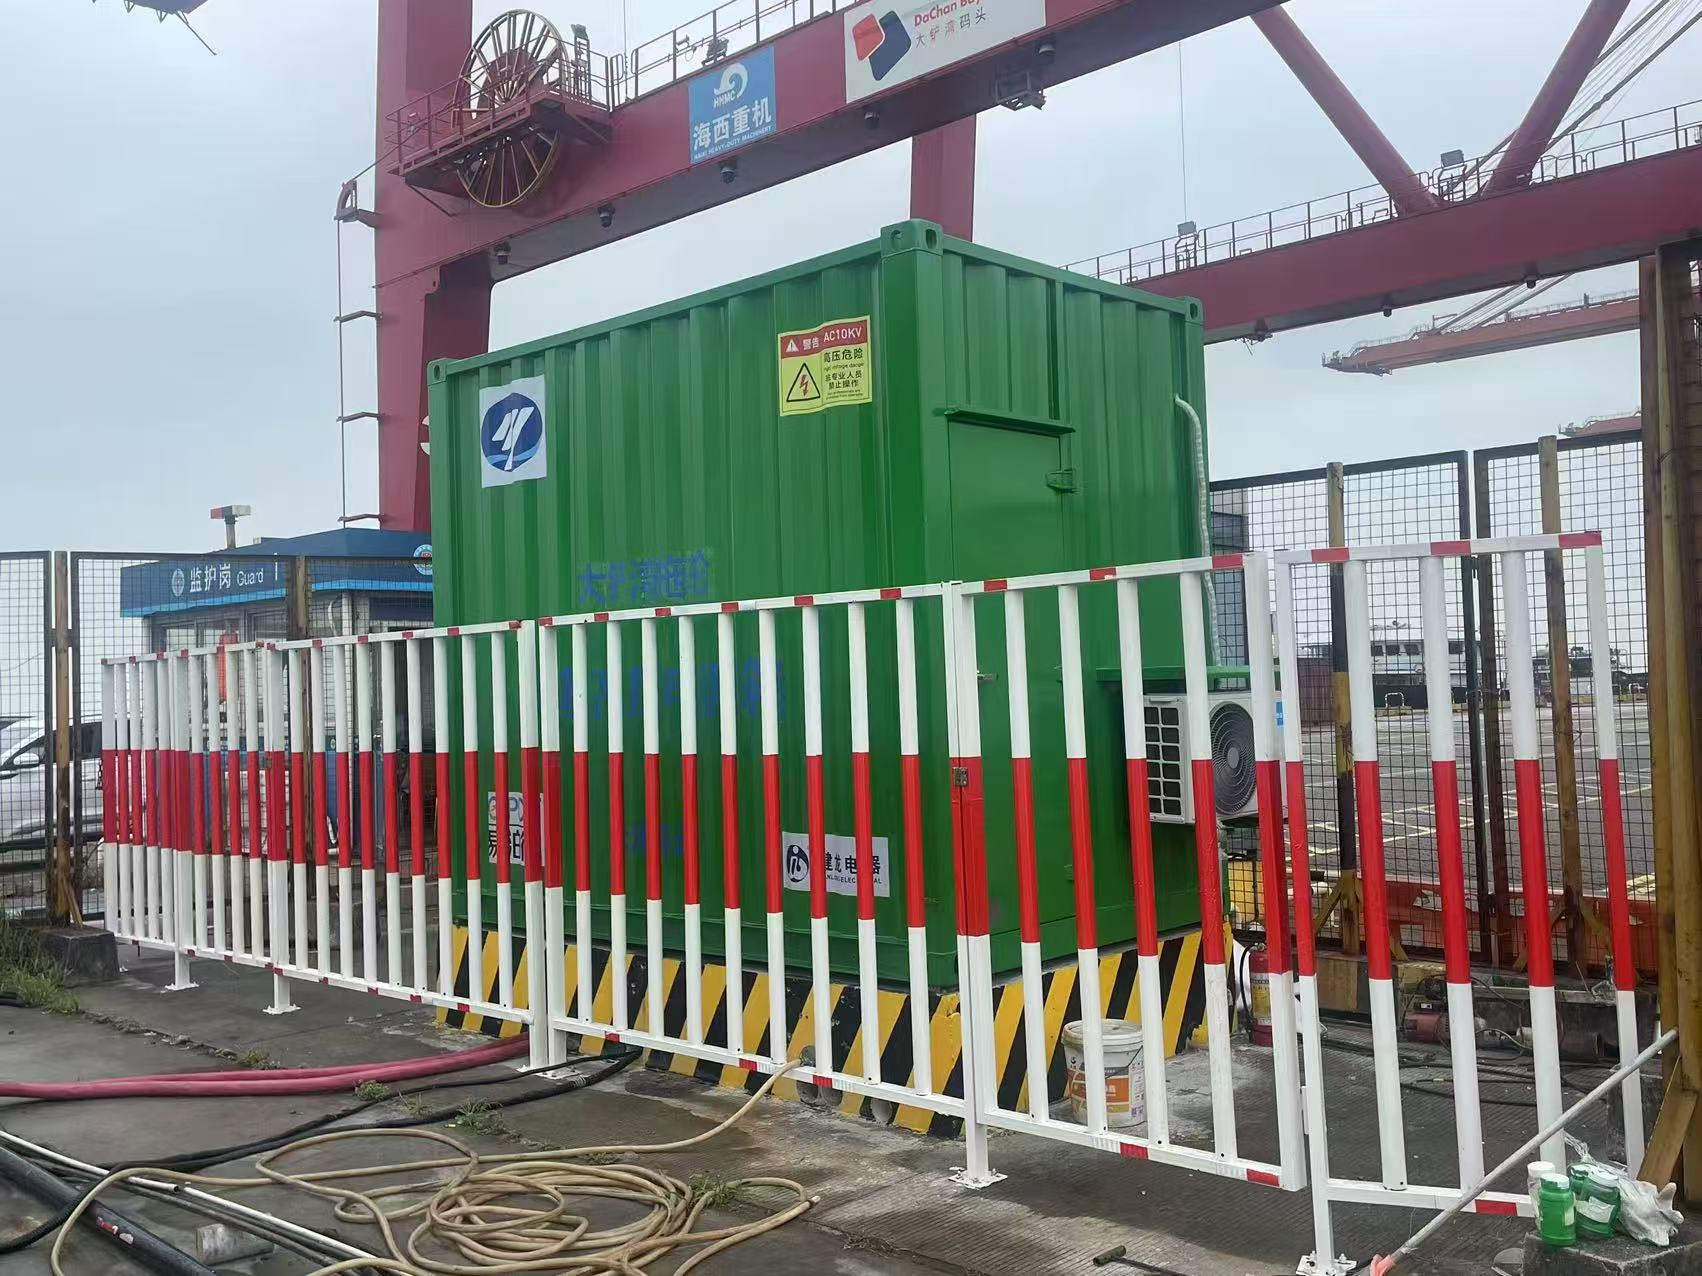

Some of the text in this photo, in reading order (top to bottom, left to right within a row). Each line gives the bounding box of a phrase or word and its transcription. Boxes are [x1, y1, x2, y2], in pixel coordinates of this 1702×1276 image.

[914, 2, 957, 27] DaChan
[693, 97, 772, 151] 海西重机
[823, 327, 862, 343] AC10KV
[823, 347, 863, 363] 高压危险
[190, 562, 264, 593] 监护岗 Guard
